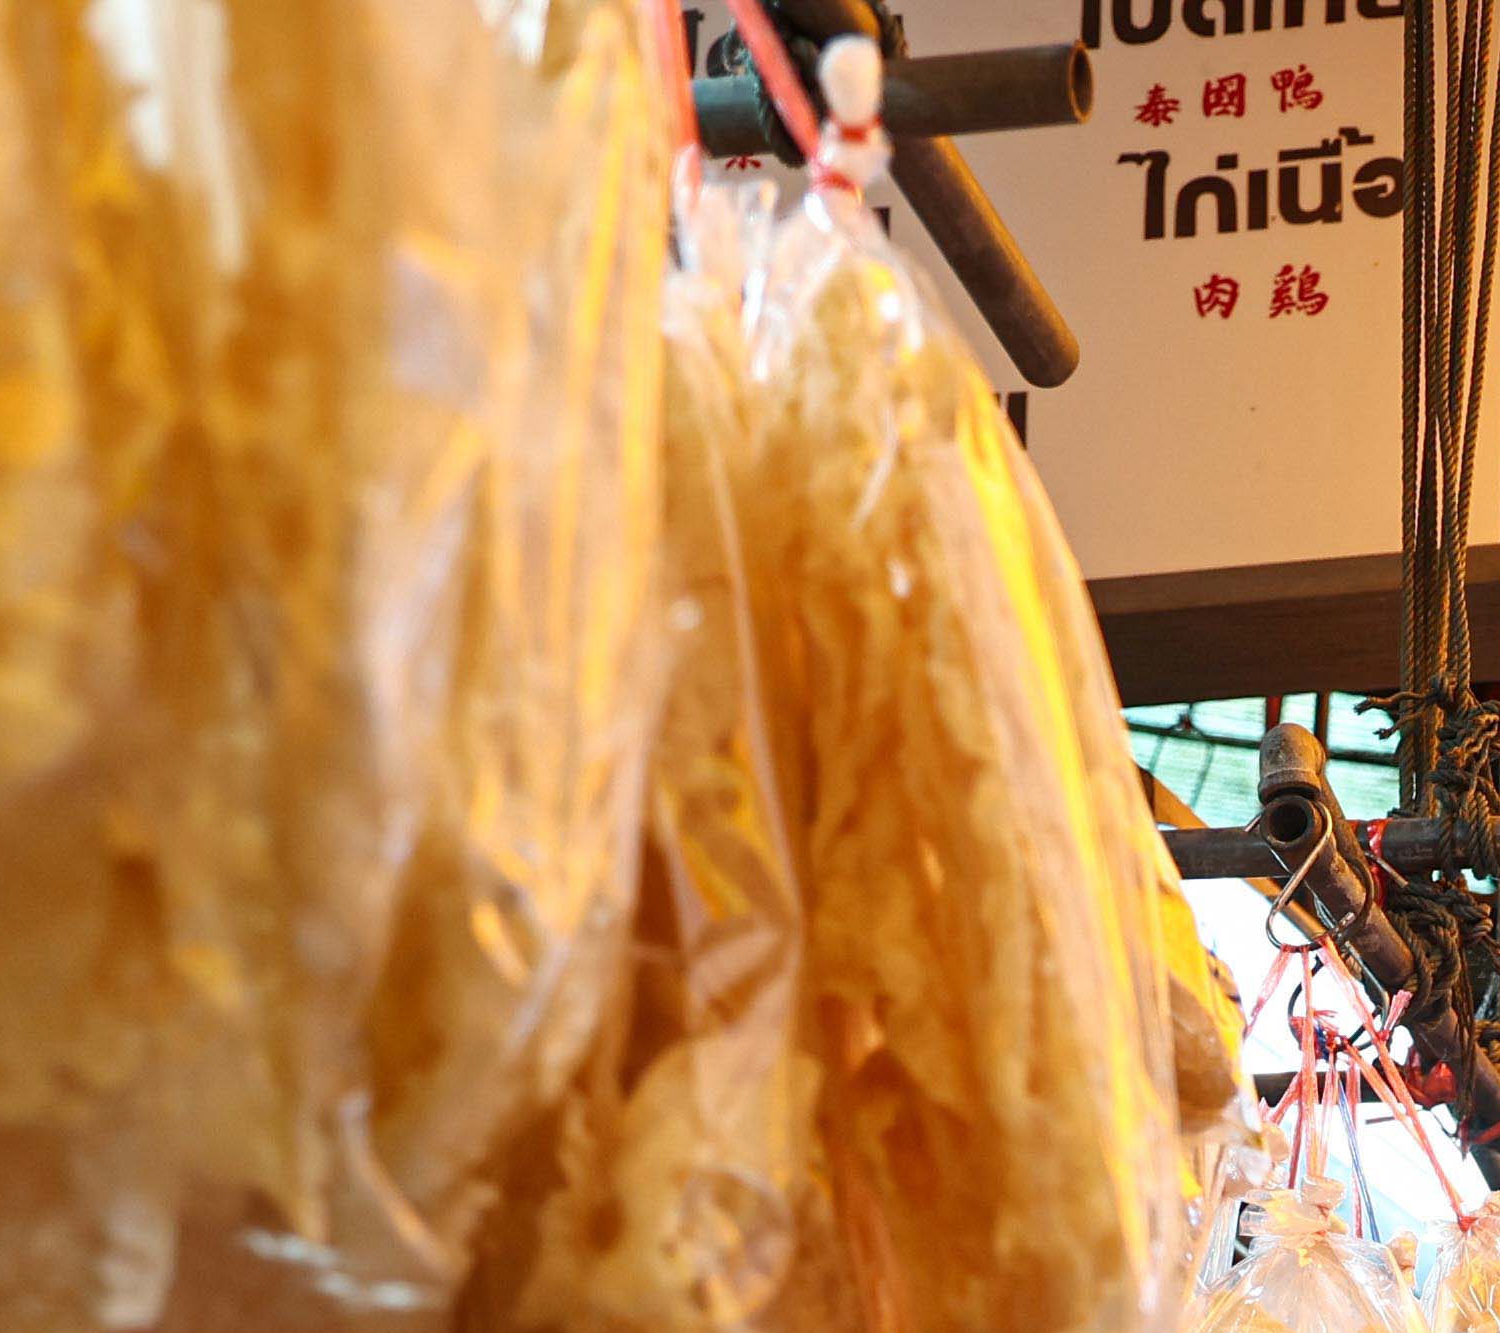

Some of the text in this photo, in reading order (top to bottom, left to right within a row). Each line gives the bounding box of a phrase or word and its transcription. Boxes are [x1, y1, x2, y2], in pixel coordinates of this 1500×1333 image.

[1134, 64, 1324, 128] 泰國鴨
[1117, 127, 1405, 241] ไก่เนื้อ
